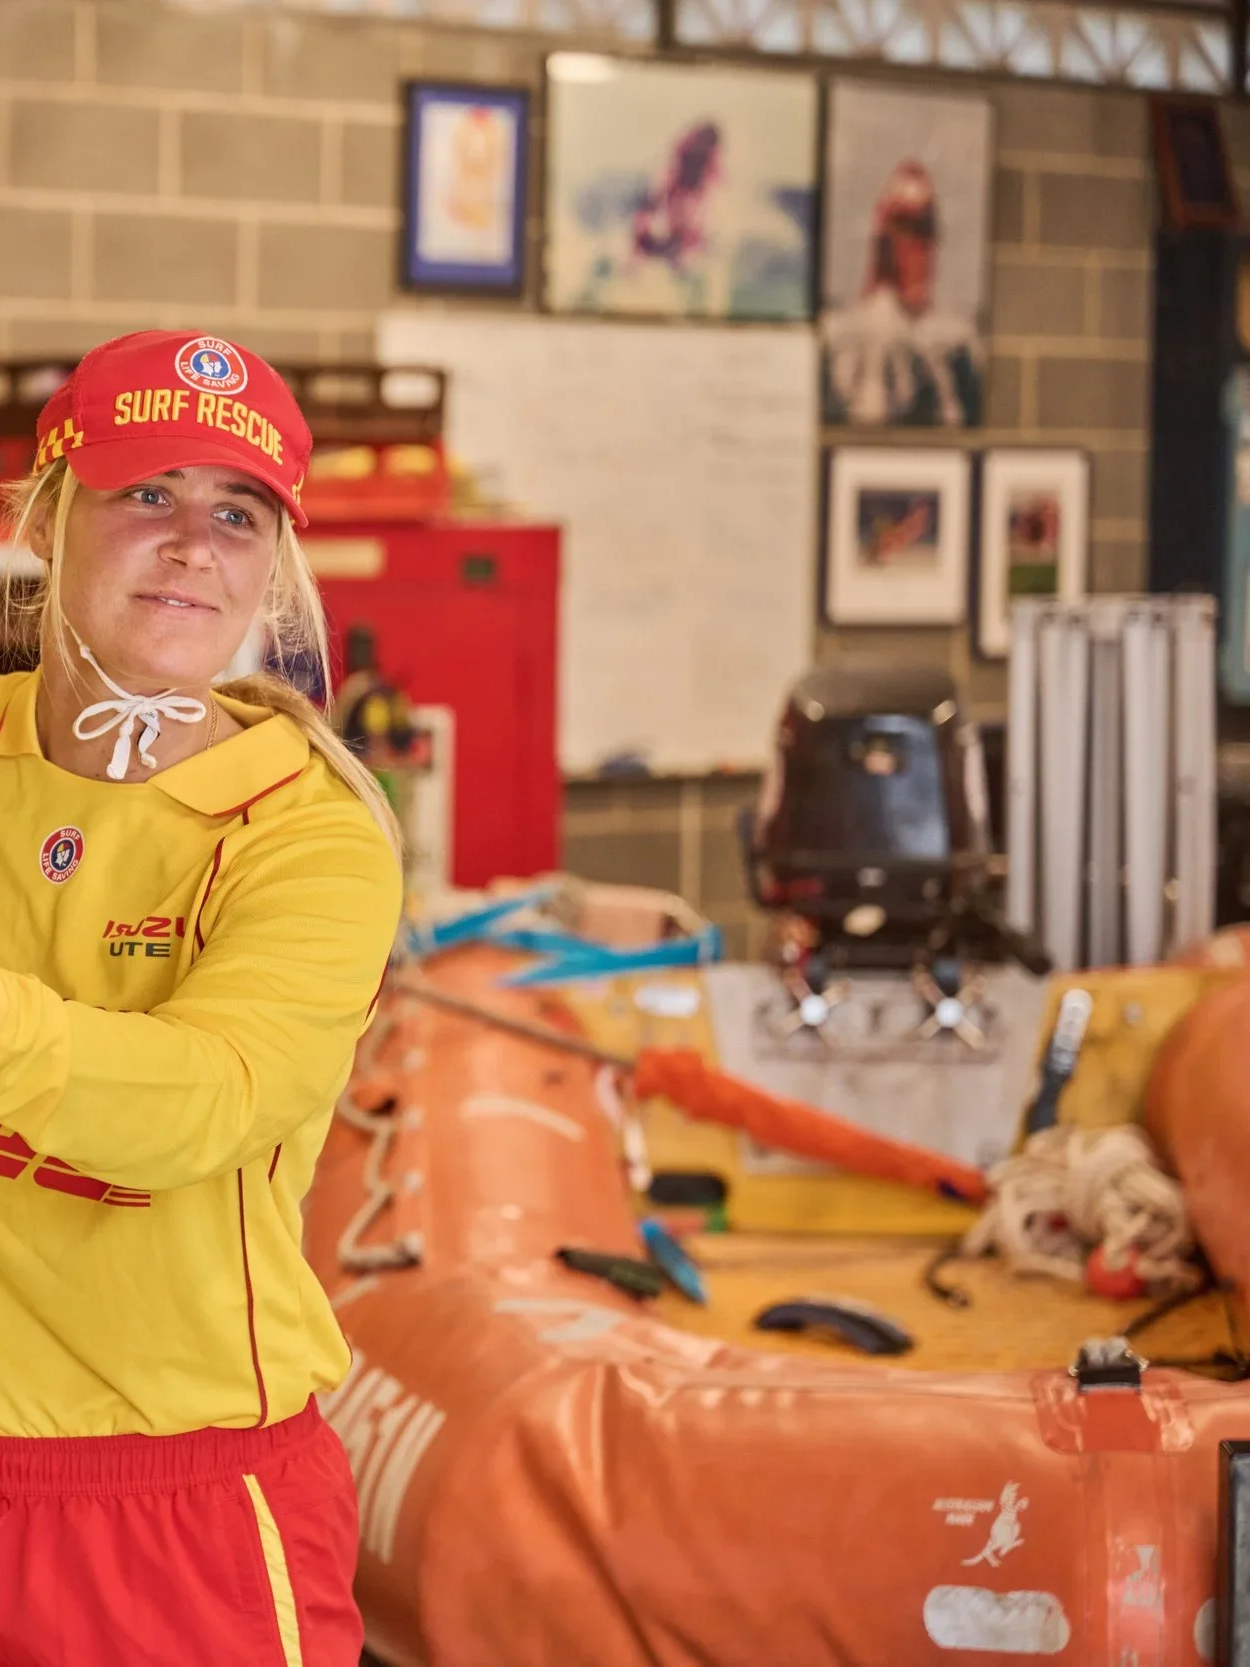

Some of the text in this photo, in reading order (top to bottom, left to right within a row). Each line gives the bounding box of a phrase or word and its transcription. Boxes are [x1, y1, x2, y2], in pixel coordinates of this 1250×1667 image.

[198, 339, 232, 356] SURF
[180, 361, 240, 388] LIFE SAVING
[114, 388, 283, 466] SURF RESCUE
[60, 829, 80, 841] SURF
[42, 852, 79, 881] LIFE SAVING
[110, 941, 171, 957] UTE
